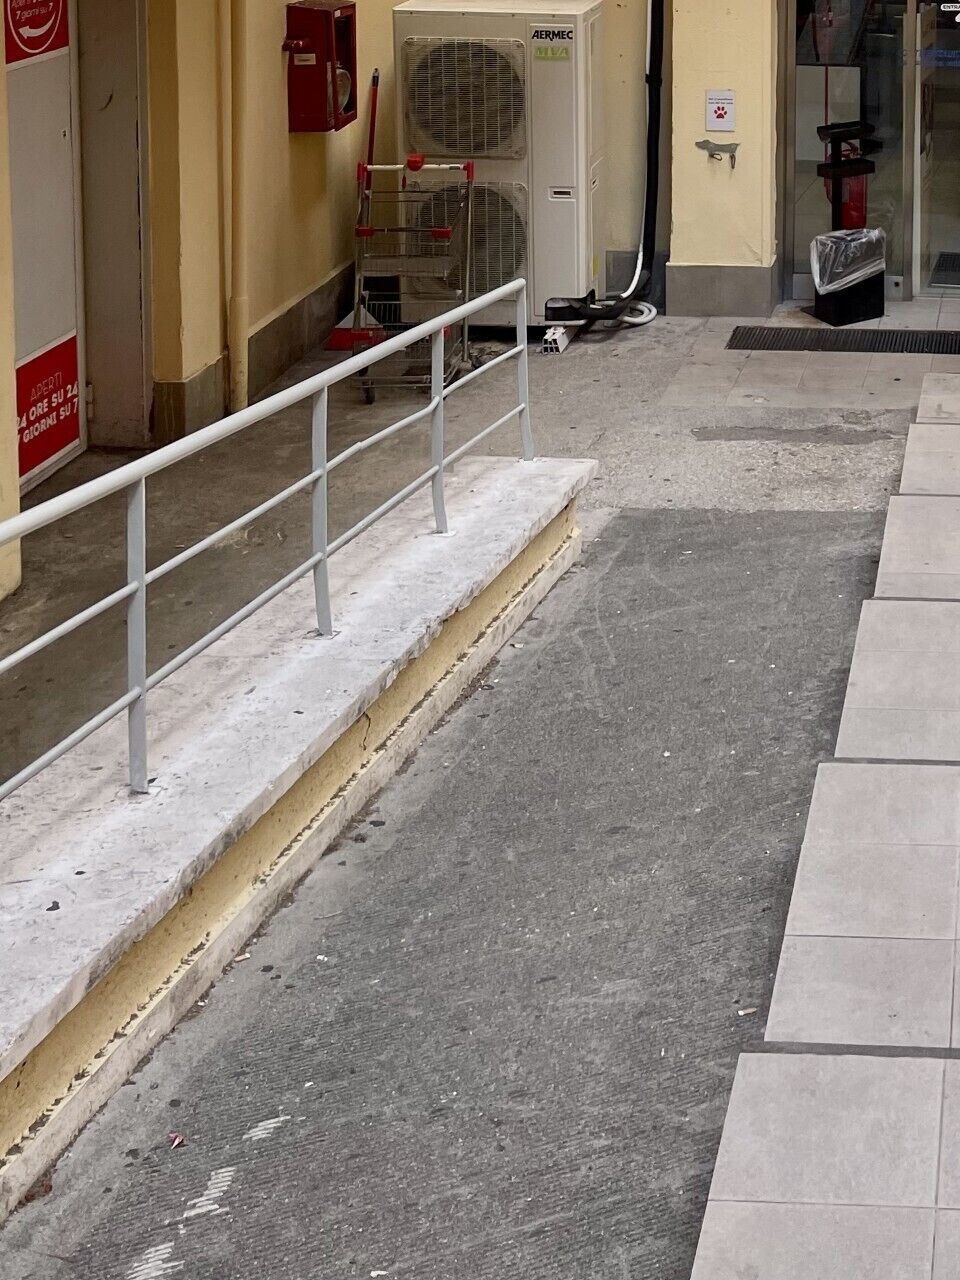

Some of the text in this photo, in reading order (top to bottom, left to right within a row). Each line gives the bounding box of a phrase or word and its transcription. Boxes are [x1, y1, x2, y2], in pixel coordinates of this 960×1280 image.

[15, 10, 21, 20] 7
[21, 6, 39, 21] giorni
[48, 2, 53, 11] 7
[531, 30, 573, 41] AERMEC
[31, 372, 62, 402] APERTI
[29, 399, 49, 420] ORE
[52, 389, 64, 407] SU
[23, 411, 57, 443] GIORNI
[60, 402, 71, 420] SU
